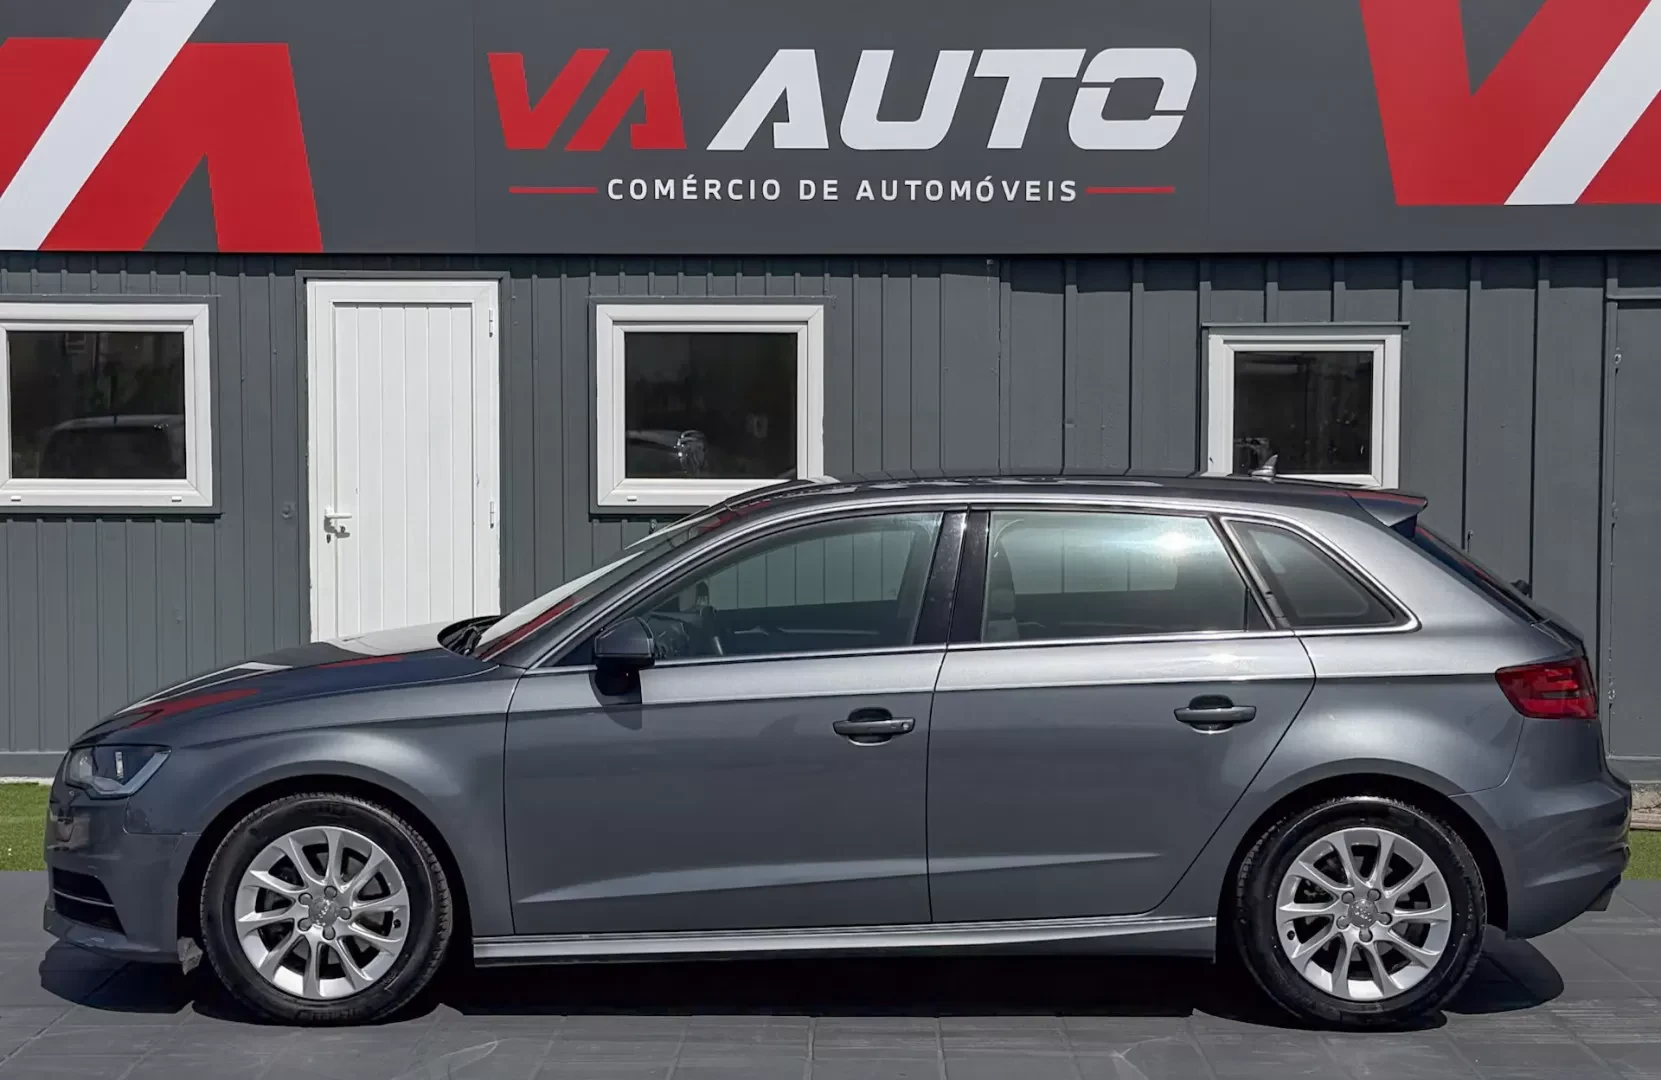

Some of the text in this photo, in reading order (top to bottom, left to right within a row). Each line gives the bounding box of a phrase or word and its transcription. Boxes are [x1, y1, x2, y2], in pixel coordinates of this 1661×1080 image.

[487, 47, 1198, 152] VA AUTO
[607, 173, 1076, 202] COMÉRCIO DE AUTOMÓVEIS
